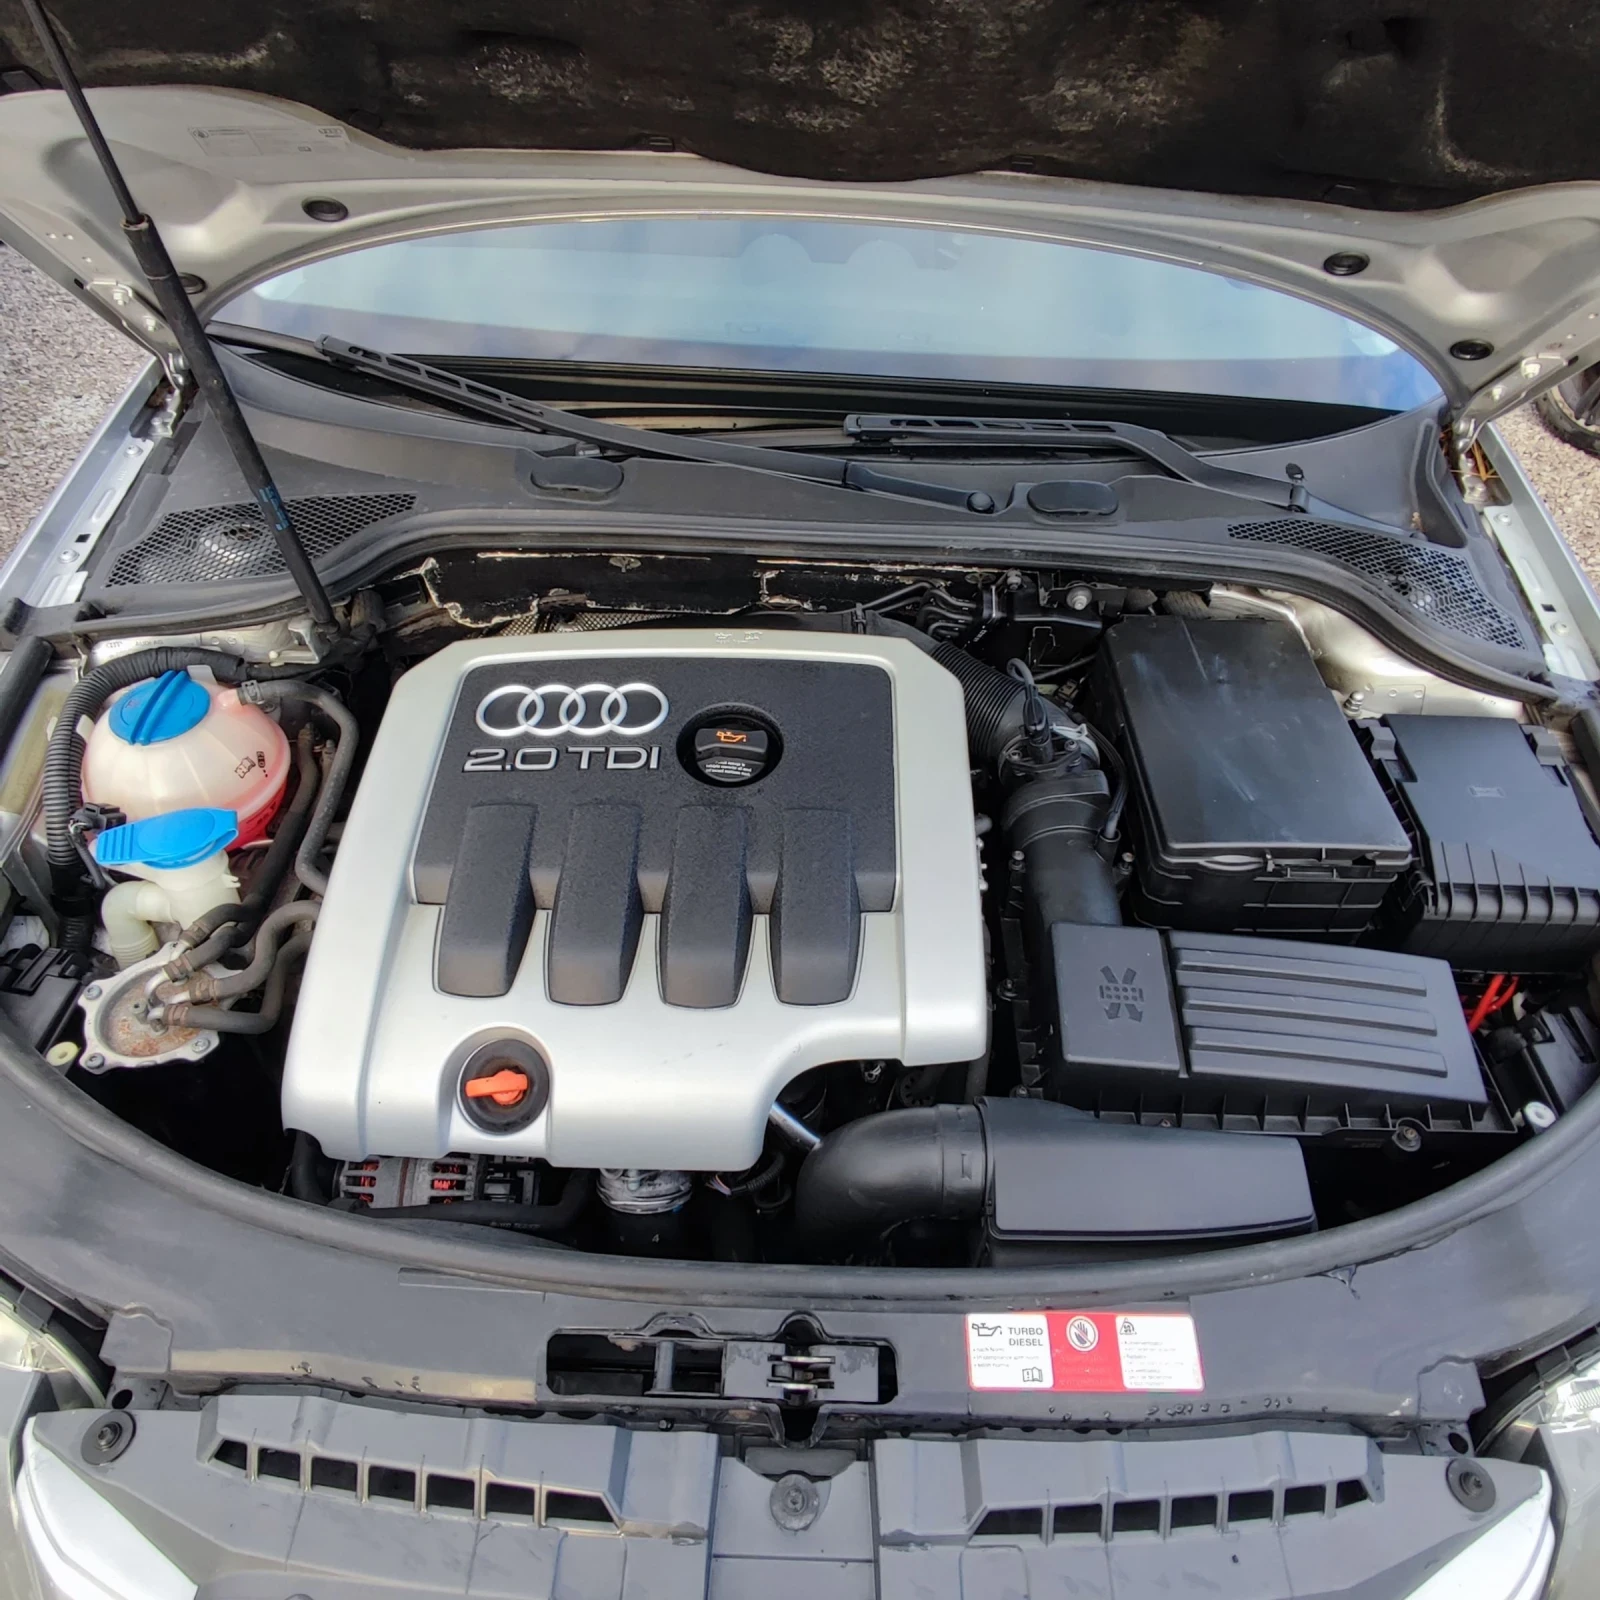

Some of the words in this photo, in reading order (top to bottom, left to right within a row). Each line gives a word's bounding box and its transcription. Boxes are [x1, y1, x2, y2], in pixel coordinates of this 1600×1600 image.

[462, 747, 561, 772] 2.0
[566, 745, 661, 771] TDI
[1008, 1327, 1044, 1336] TURBO
[1009, 1338, 1043, 1347] DIESEL
